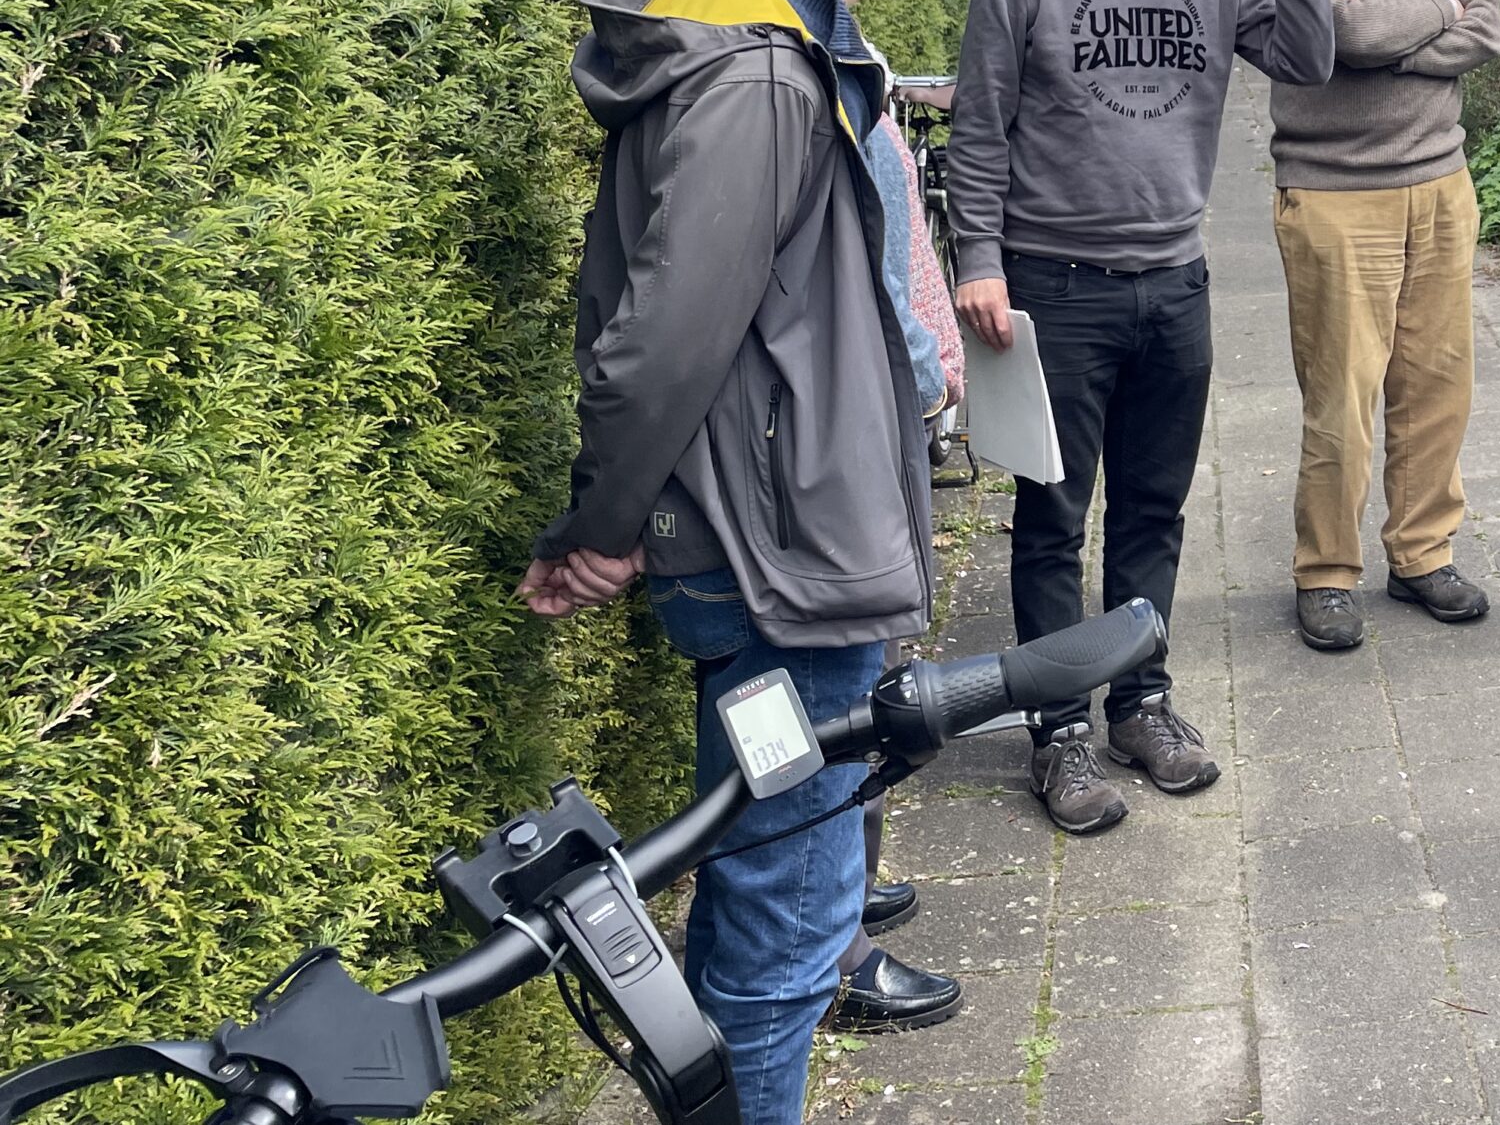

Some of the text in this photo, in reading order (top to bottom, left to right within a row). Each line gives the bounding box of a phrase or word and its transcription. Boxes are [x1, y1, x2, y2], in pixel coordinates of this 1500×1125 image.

[1070, 20, 1081, 35] BE
[1089, 7, 1194, 39] UNITED
[1073, 38, 1207, 73] FAILURES
[1088, 81, 1192, 120] FAIL AGAIN FAIL BETTER
